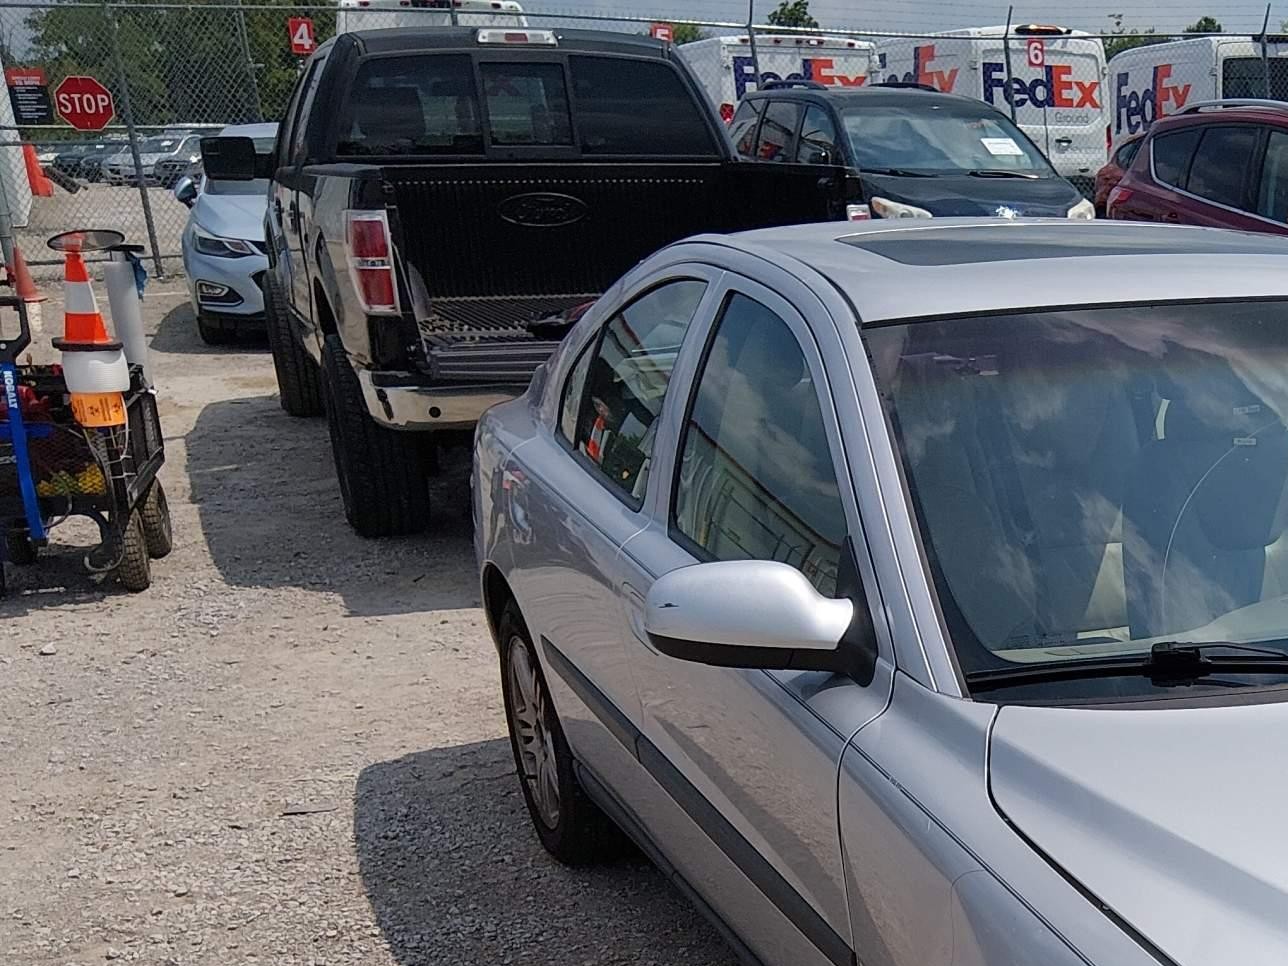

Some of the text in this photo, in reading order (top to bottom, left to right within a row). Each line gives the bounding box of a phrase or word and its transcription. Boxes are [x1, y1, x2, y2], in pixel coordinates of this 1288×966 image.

[293, 23, 313, 49] 4
[1028, 42, 1043, 65] 6
[982, 63, 1101, 108] FedEx
[58, 93, 109, 114] STOP
[1054, 112, 1089, 124] Ground
[3, 370, 18, 409] KOBALT
